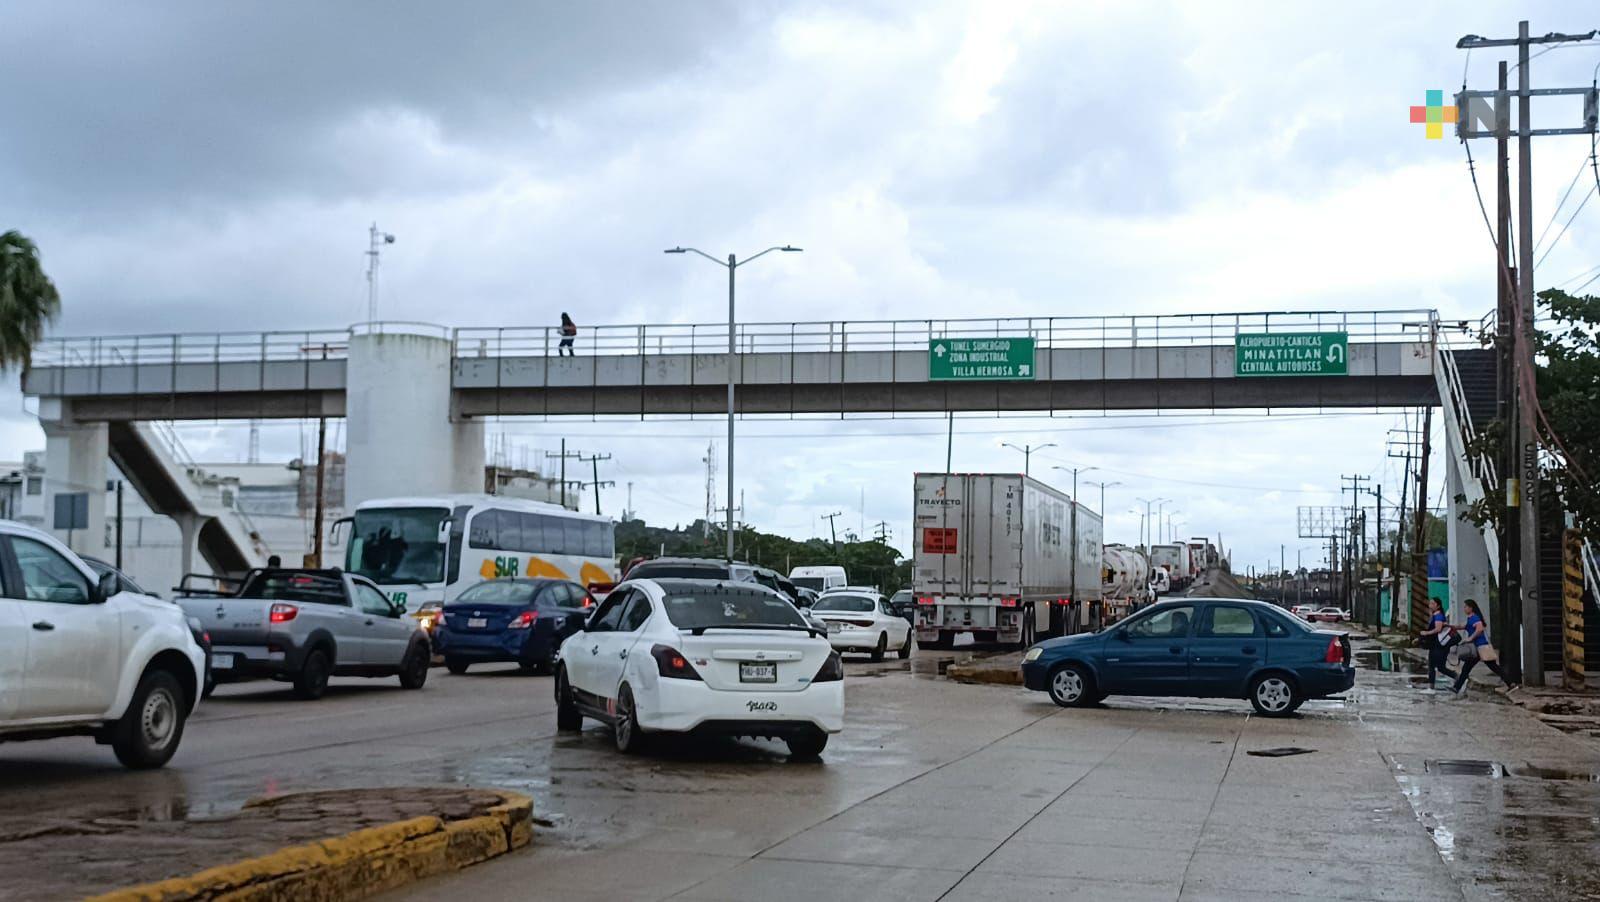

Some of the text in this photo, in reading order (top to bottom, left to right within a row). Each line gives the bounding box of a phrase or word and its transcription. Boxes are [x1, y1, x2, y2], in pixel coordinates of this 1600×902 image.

[949, 352, 1008, 362] ZONA INDUSTRIAL
[1244, 348, 1321, 360] MINATITLAN
[952, 366, 1013, 377] VILLA HERMOSA
[1241, 361, 1322, 372] CENTRAL AUTOBUSES
[495, 556, 519, 577] SUR
